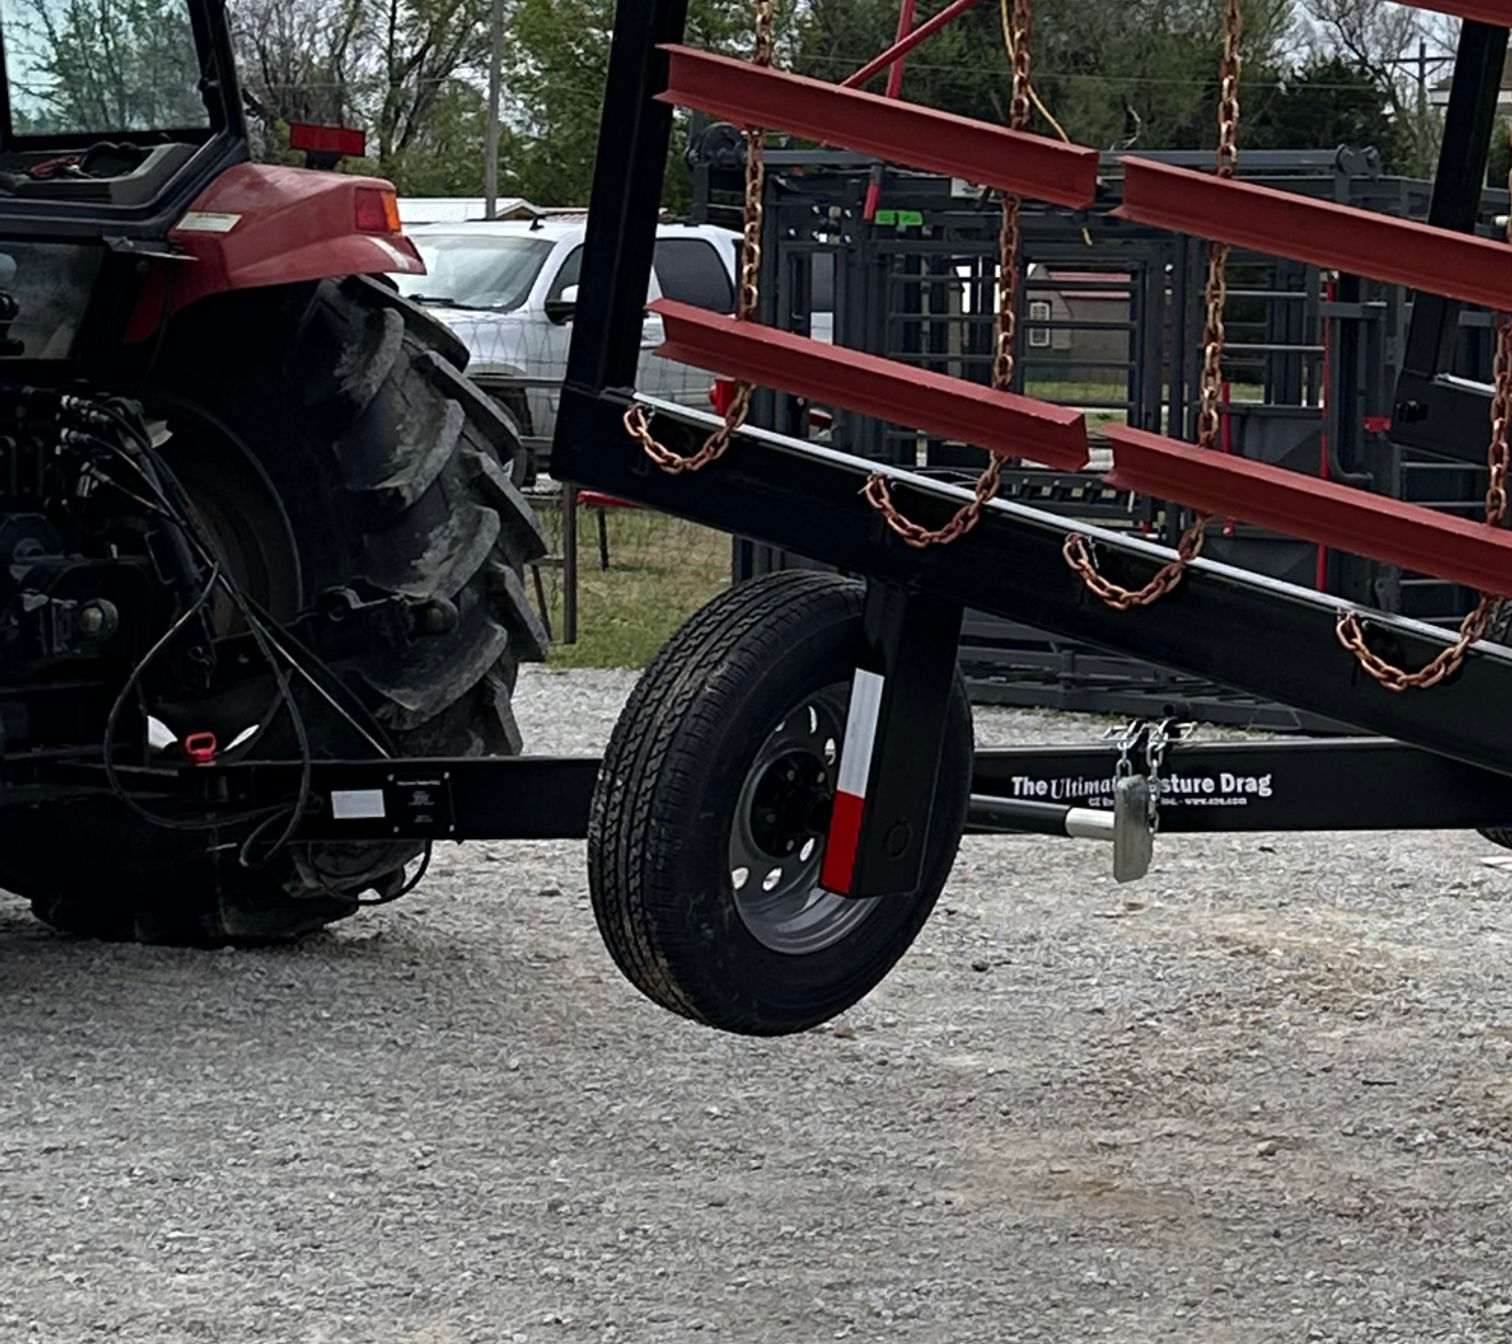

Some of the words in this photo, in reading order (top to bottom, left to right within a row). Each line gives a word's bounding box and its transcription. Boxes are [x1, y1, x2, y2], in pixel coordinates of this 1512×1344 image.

[1011, 775, 1049, 796] The
[1051, 776, 1117, 800] Ultimat
[1159, 773, 1215, 794] sture
[1219, 772, 1273, 797] Drag
